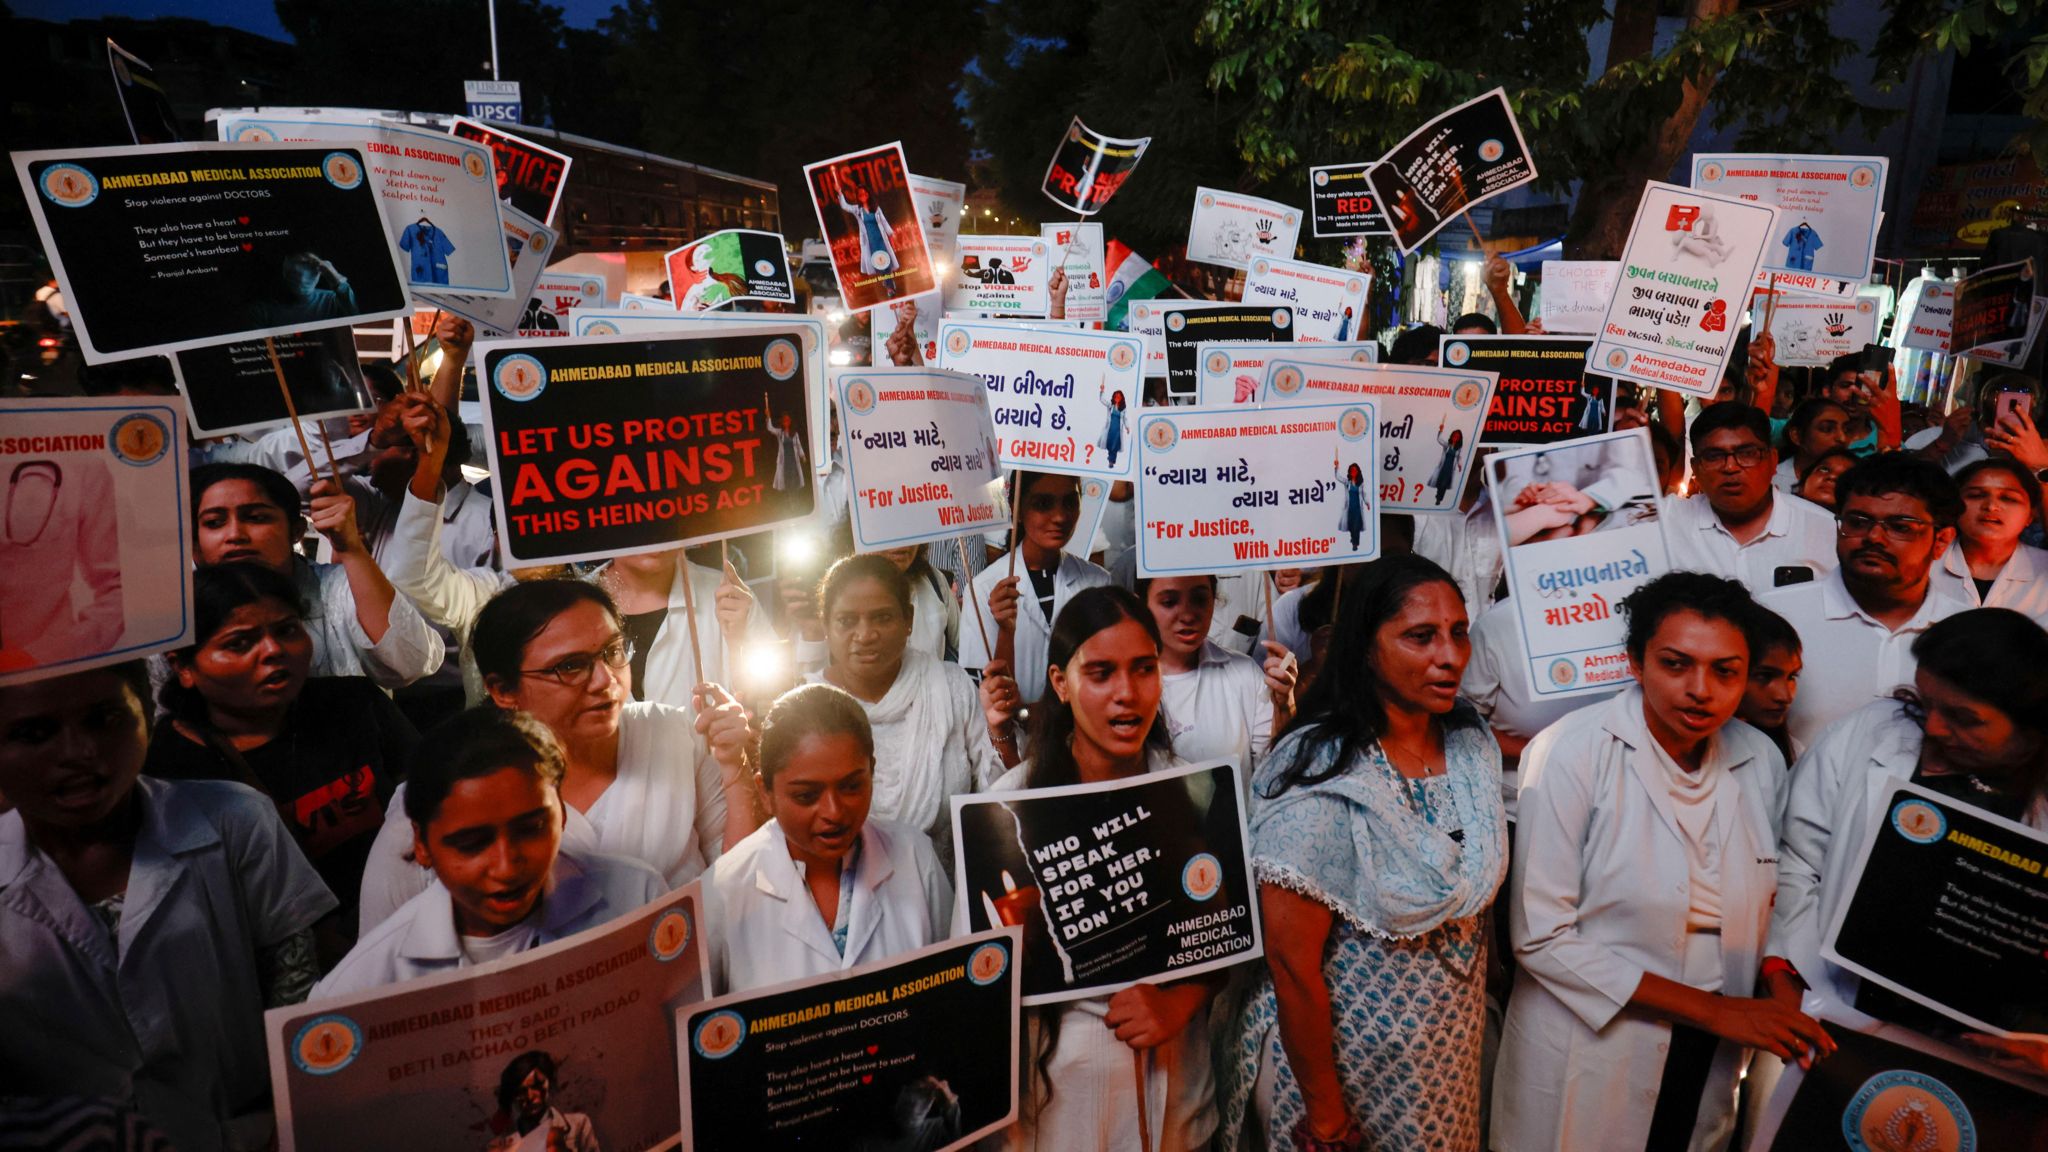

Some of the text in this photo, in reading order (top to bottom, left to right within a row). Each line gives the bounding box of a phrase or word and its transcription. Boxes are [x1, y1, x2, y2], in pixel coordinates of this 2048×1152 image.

[472, 104, 517, 120] UPSC
[367, 142, 461, 167] EDICAL ASSOCIATION
[1405, 127, 1453, 178] WHO WILL
[102, 166, 322, 190] AHMEDABAD MEDICAL ASSOCIATION
[1411, 149, 1440, 185] SPEAK
[1416, 169, 1435, 191] FOR
[1422, 182, 1435, 197] IF
[1438, 157, 1457, 178] YOU
[1476, 156, 1523, 181] AHMEDABAD
[1485, 167, 1519, 185] MEDICAL
[1726, 169, 1847, 182] AHMEDABAD MEDICAL ASSOCIATION
[385, 178, 438, 193] Stethos and
[815, 154, 906, 207] JUSTICE
[1480, 169, 1530, 195] ASSOCIATION
[124, 189, 271, 208] Stop violence against DOCTORS
[381, 188, 446, 206] Scalpels today
[1337, 197, 1373, 214] RED
[134, 225, 158, 237] They
[160, 223, 180, 233] also
[180, 219, 203, 232] have
[213, 218, 237, 228] heart
[144, 245, 240, 263] Someone's heartbeat
[748, 279, 787, 288] AHMEDABAD
[755, 285, 782, 293] MEDICAL
[957, 283, 1034, 292] Stop VIOLENCE
[1572, 280, 1600, 292] THE
[1626, 265, 1720, 295] જીવન બચાવનારને
[749, 290, 790, 299] ASSOCIATION
[969, 300, 1022, 309] DOCTOR
[1631, 286, 1700, 310] જીવ બચાવવા
[1628, 305, 1691, 329] ભાગવું પડે!!
[972, 340, 1107, 360] AHMEDABAD MEDICAL ASSOCIATION
[1606, 323, 1627, 337] હિંસા
[1695, 343, 1726, 358] બચાવો
[1471, 350, 1585, 359] AHMEDABAD MEDICAL ASSOCIATION
[1633, 353, 1708, 377] Ahmedabad
[550, 355, 762, 383] AHMEDABAD MEDICAL ASSOCIATION
[1629, 364, 1703, 388] Medical Association
[1013, 370, 1075, 400] બીજાની
[1306, 379, 1452, 399] AHMEDABAD MEDICAL ASSOCIATION
[1500, 379, 1577, 394] PROTEST
[994, 402, 1072, 432] બચાવે છે.
[1487, 396, 1576, 419] AINST
[500, 408, 759, 456] LET US PROTEST
[851, 421, 946, 450] “ન્યાય માટે,
[1180, 421, 1337, 441] AHMEDABAD MEDICAL ASSOCIATION
[1541, 421, 1574, 433] ACT
[931, 455, 963, 472] ન્યાય
[1010, 436, 1076, 465] બચાવશે
[1084, 444, 1095, 465] ?
[1383, 446, 1404, 472] છે.
[511, 438, 762, 507] AGAINST
[1145, 458, 1256, 486] “ન્યાય માટે,
[859, 482, 953, 509] “For Justice,
[1232, 479, 1337, 509] ન્યાય સાથે”
[512, 484, 764, 536] THIS HEINOUS ACT
[1147, 517, 1256, 540] “For Justice,
[1233, 536, 1337, 561] With Justice"
[1538, 549, 1649, 591] બચાવનારને
[1544, 592, 1611, 626] મારશો
[1585, 669, 1625, 684] Medical
[1033, 805, 1152, 865] WHO WILL
[1042, 841, 1118, 883] SPEAK
[1946, 829, 2042, 875] AHMEDABAD
[1049, 848, 1162, 903] FOR HER,
[1055, 871, 1145, 922] IF YOU
[1062, 891, 1150, 942] DON'T?
[1166, 904, 1247, 937] AHMEDABAD
[1180, 920, 1237, 949] MEDICAL
[1166, 935, 1252, 968] ASSOCIATION
[368, 942, 648, 1043] AHMEDABAD MEDICAL ASSOCIATION
[750, 964, 965, 1035] AHMEDABAD MEDICAL ASSOCIATION
[388, 988, 641, 1082] BETI BACHAO BETI PADAO
[469, 1004, 562, 1043] THEY SAID
[765, 1009, 909, 1053] Stop violence against DOCTORS
[767, 1048, 865, 1083] They also have a heart
[767, 1052, 916, 1098] But they have to be brave to secure
[767, 1078, 860, 1112] Someone's heartbeat
